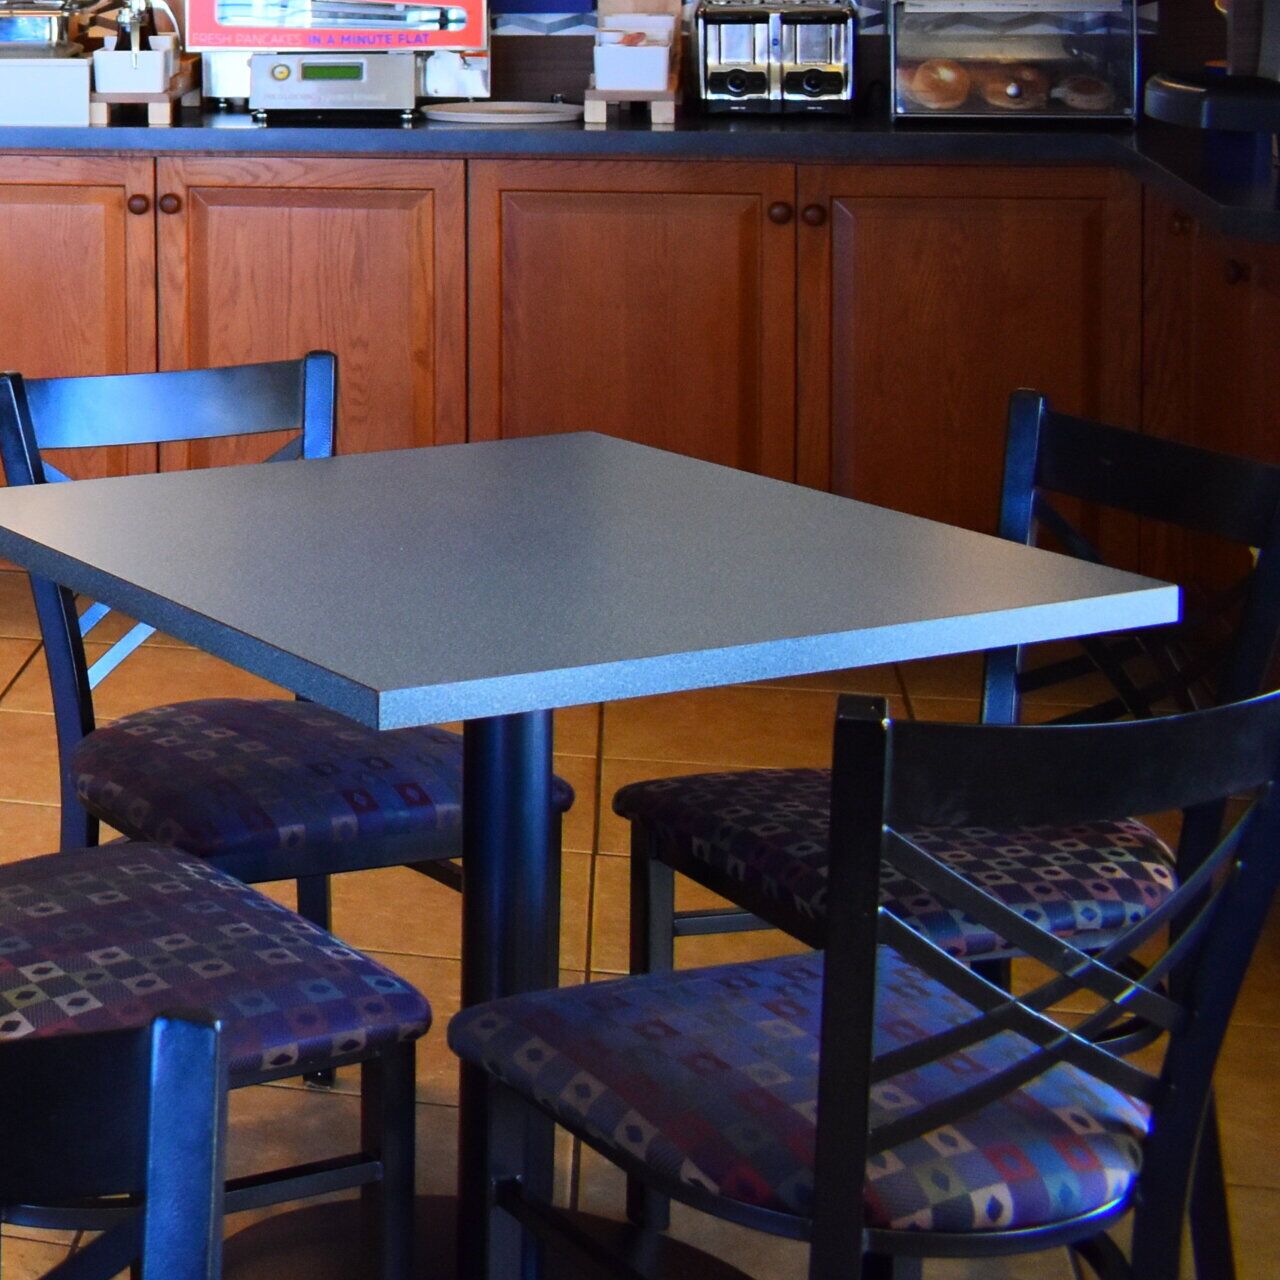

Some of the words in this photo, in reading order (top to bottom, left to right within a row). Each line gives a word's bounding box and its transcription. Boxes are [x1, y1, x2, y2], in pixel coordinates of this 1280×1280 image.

[308, 34, 321, 44] IN
[340, 33, 392, 44] MINUTE
[398, 33, 430, 44] FLAT
